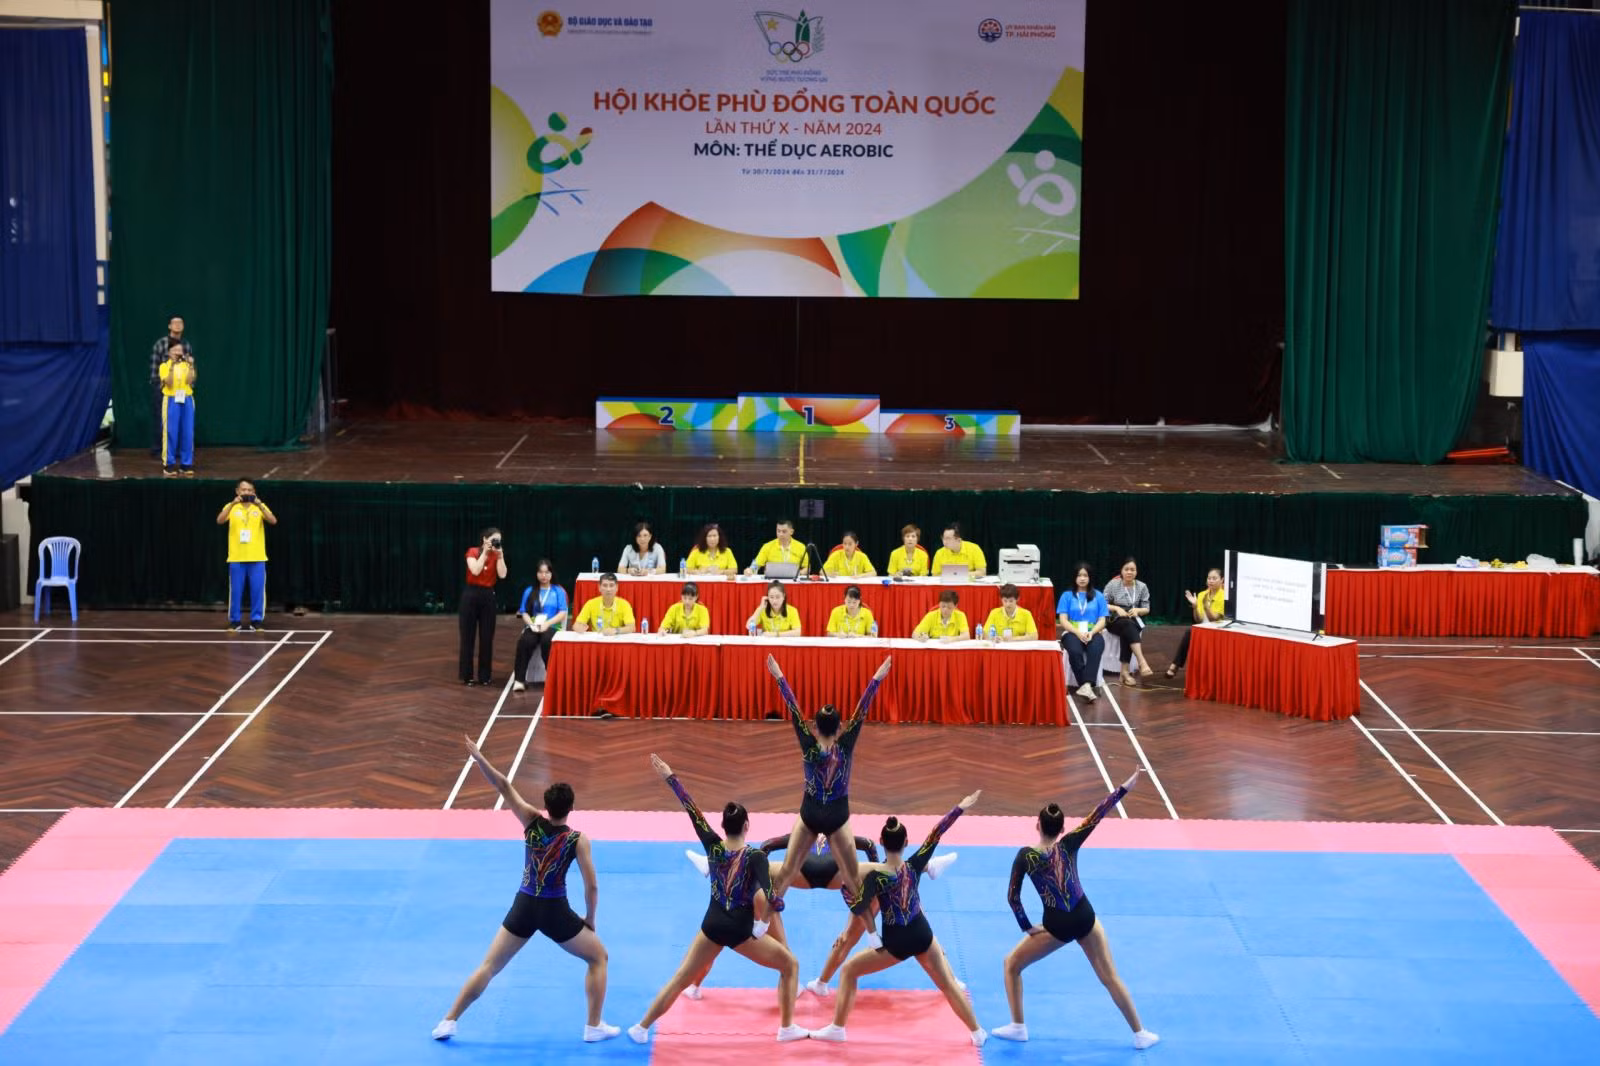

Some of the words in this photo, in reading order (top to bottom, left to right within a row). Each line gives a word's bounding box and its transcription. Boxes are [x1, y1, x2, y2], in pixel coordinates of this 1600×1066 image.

[593, 88, 637, 115] HỘI
[644, 88, 711, 112] KHỎE
[717, 89, 766, 112] PHÙ
[772, 88, 845, 113] ĐỔNG
[850, 90, 918, 114] TOÀN
[924, 90, 996, 117] QUỐC
[705, 117, 736, 134] LẦN
[740, 118, 776, 134] THỨ
[779, 121, 789, 134] X
[804, 119, 841, 135] NĂM
[845, 122, 882, 136] 2024
[694, 140, 740, 157] MÔN:
[743, 138, 777, 157] THỂ
[781, 143, 817, 160] DỤC
[820, 144, 894, 158] AEROBIC
[659, 406, 675, 425] 2
[803, 406, 815, 426] 1
[944, 417, 955, 430] 3
